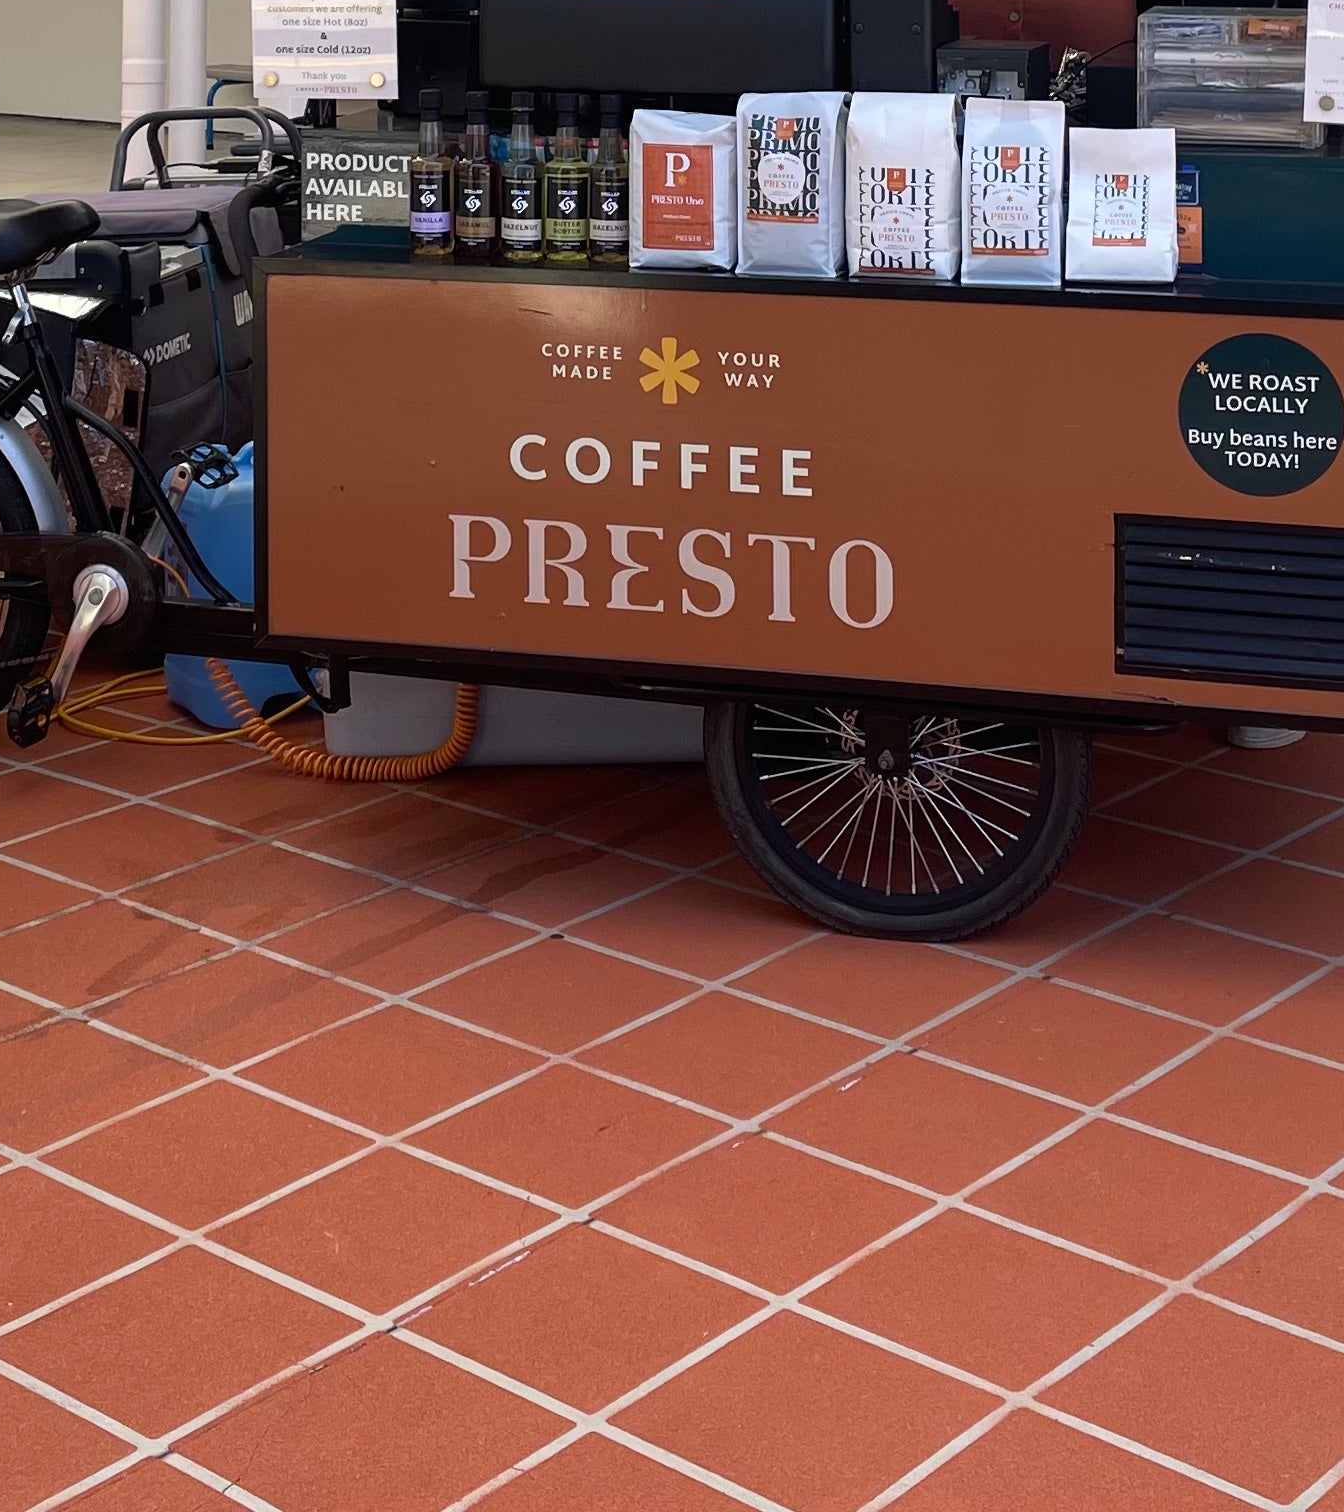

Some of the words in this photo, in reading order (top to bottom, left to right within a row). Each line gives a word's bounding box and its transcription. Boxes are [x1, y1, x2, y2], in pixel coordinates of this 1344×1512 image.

[267, 5, 314, 13] customers
[347, 4, 383, 15] offering
[302, 18, 321, 26] size
[323, 18, 342, 26] Hot
[344, 18, 368, 27] (8oz)
[320, 32, 328, 40] &
[275, 46, 294, 54] one
[296, 45, 315, 54] size
[317, 45, 339, 54] Cold
[341, 45, 372, 55] (12oz)
[301, 72, 328, 80] Thank
[330, 73, 347, 82] you
[307, 153, 412, 173] PRODUCT
[665, 152, 691, 187] P
[305, 178, 409, 198] AVAILABL
[763, 180, 799, 189] PRESTO
[651, 194, 683, 205] PRESTO
[685, 196, 704, 205] Uno
[307, 203, 363, 222] HERE
[990, 212, 1029, 221] PRESTO
[878, 233, 915, 243] PRESTO
[156, 332, 192, 364] DOMETIC
[541, 342, 624, 362] COFFEE
[717, 350, 782, 369] YOUR
[551, 364, 613, 381] MADE
[723, 371, 776, 389] WAY
[1208, 372, 1243, 390] WE
[1249, 374, 1320, 393] ROAST
[1215, 395, 1309, 414] LOCALLY
[1188, 429, 1225, 450] Buy
[1229, 428, 1288, 448] beans
[1293, 431, 1338, 450] here
[509, 434, 813, 497] COFFEE
[1224, 451, 1300, 469] TODAY!
[448, 514, 894, 629] PRESTO
